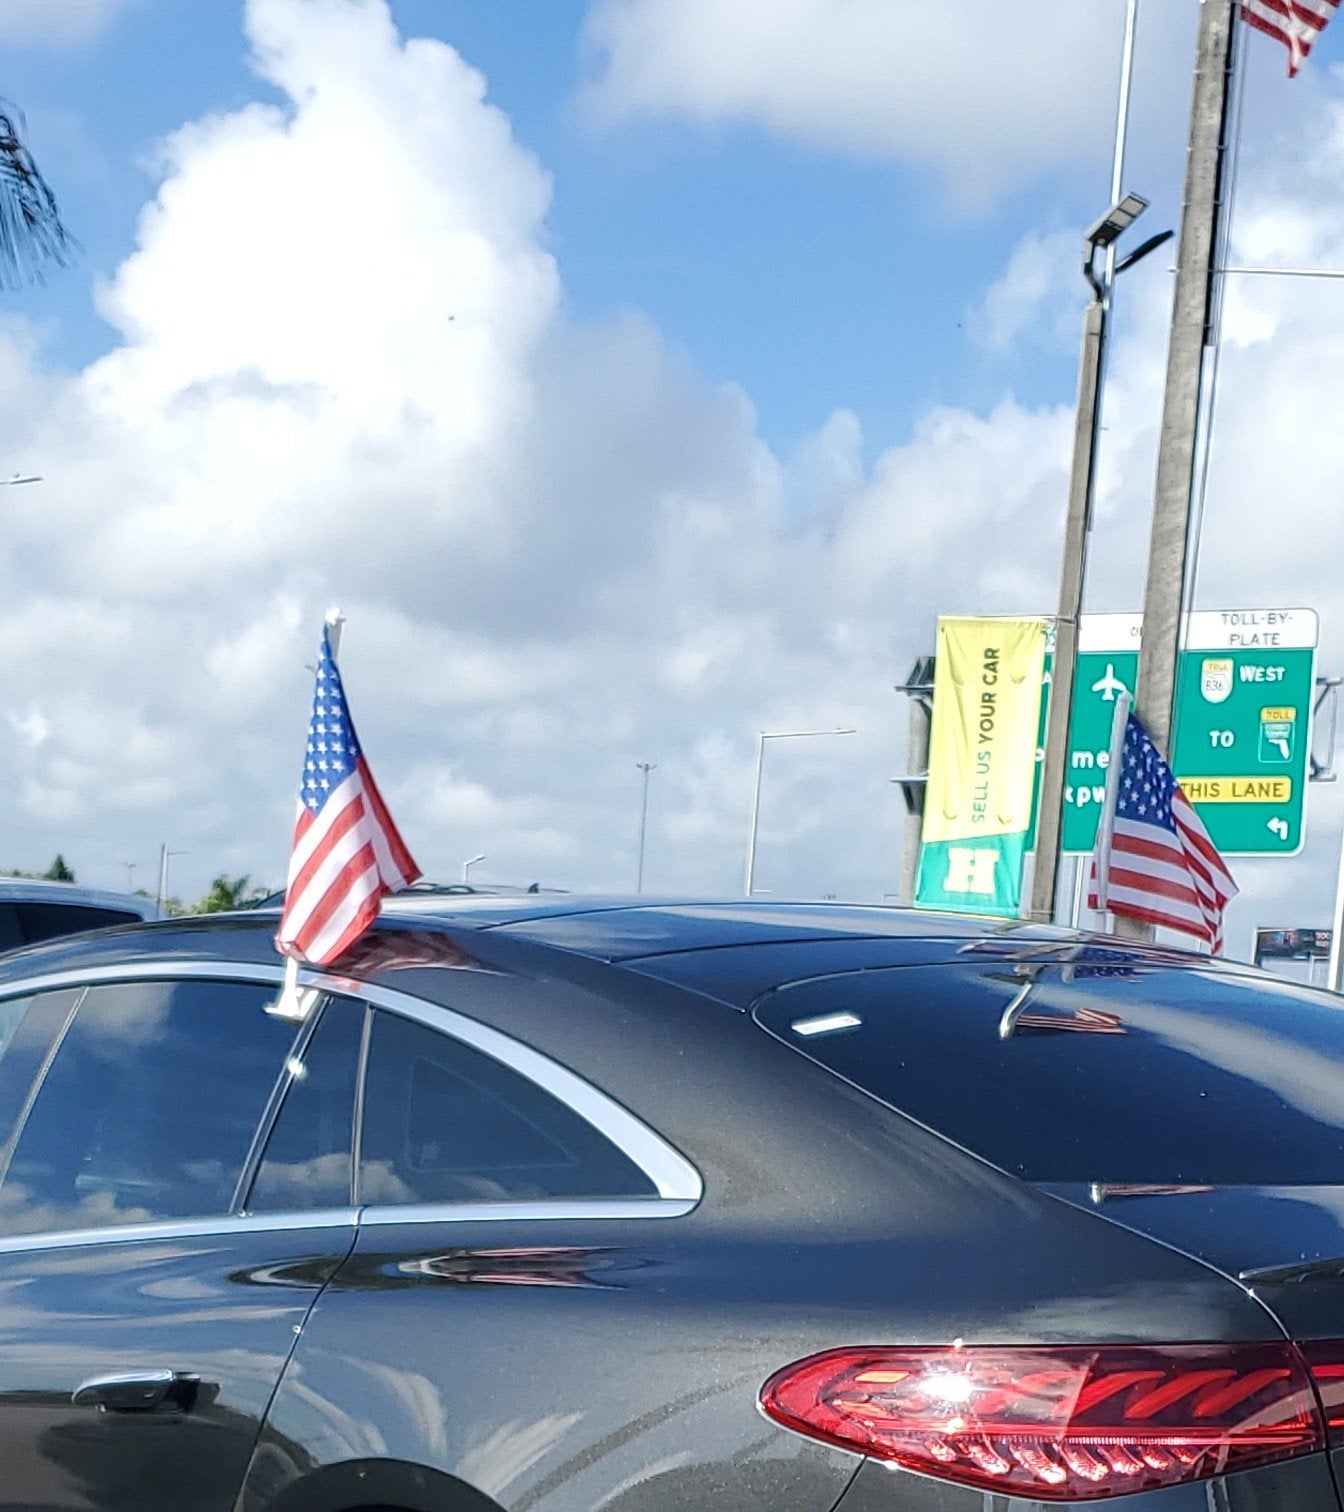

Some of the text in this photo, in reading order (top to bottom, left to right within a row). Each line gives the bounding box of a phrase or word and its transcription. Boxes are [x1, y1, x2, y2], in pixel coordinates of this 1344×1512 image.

[1222, 612, 1293, 626] TOLL-BY-
[1229, 633, 1281, 646] PLATE
[1239, 665, 1286, 683] WEST
[972, 647, 1001, 823] SELL US YOUR CAR
[1209, 730, 1235, 748] TO
[1232, 782, 1284, 798] LANE
